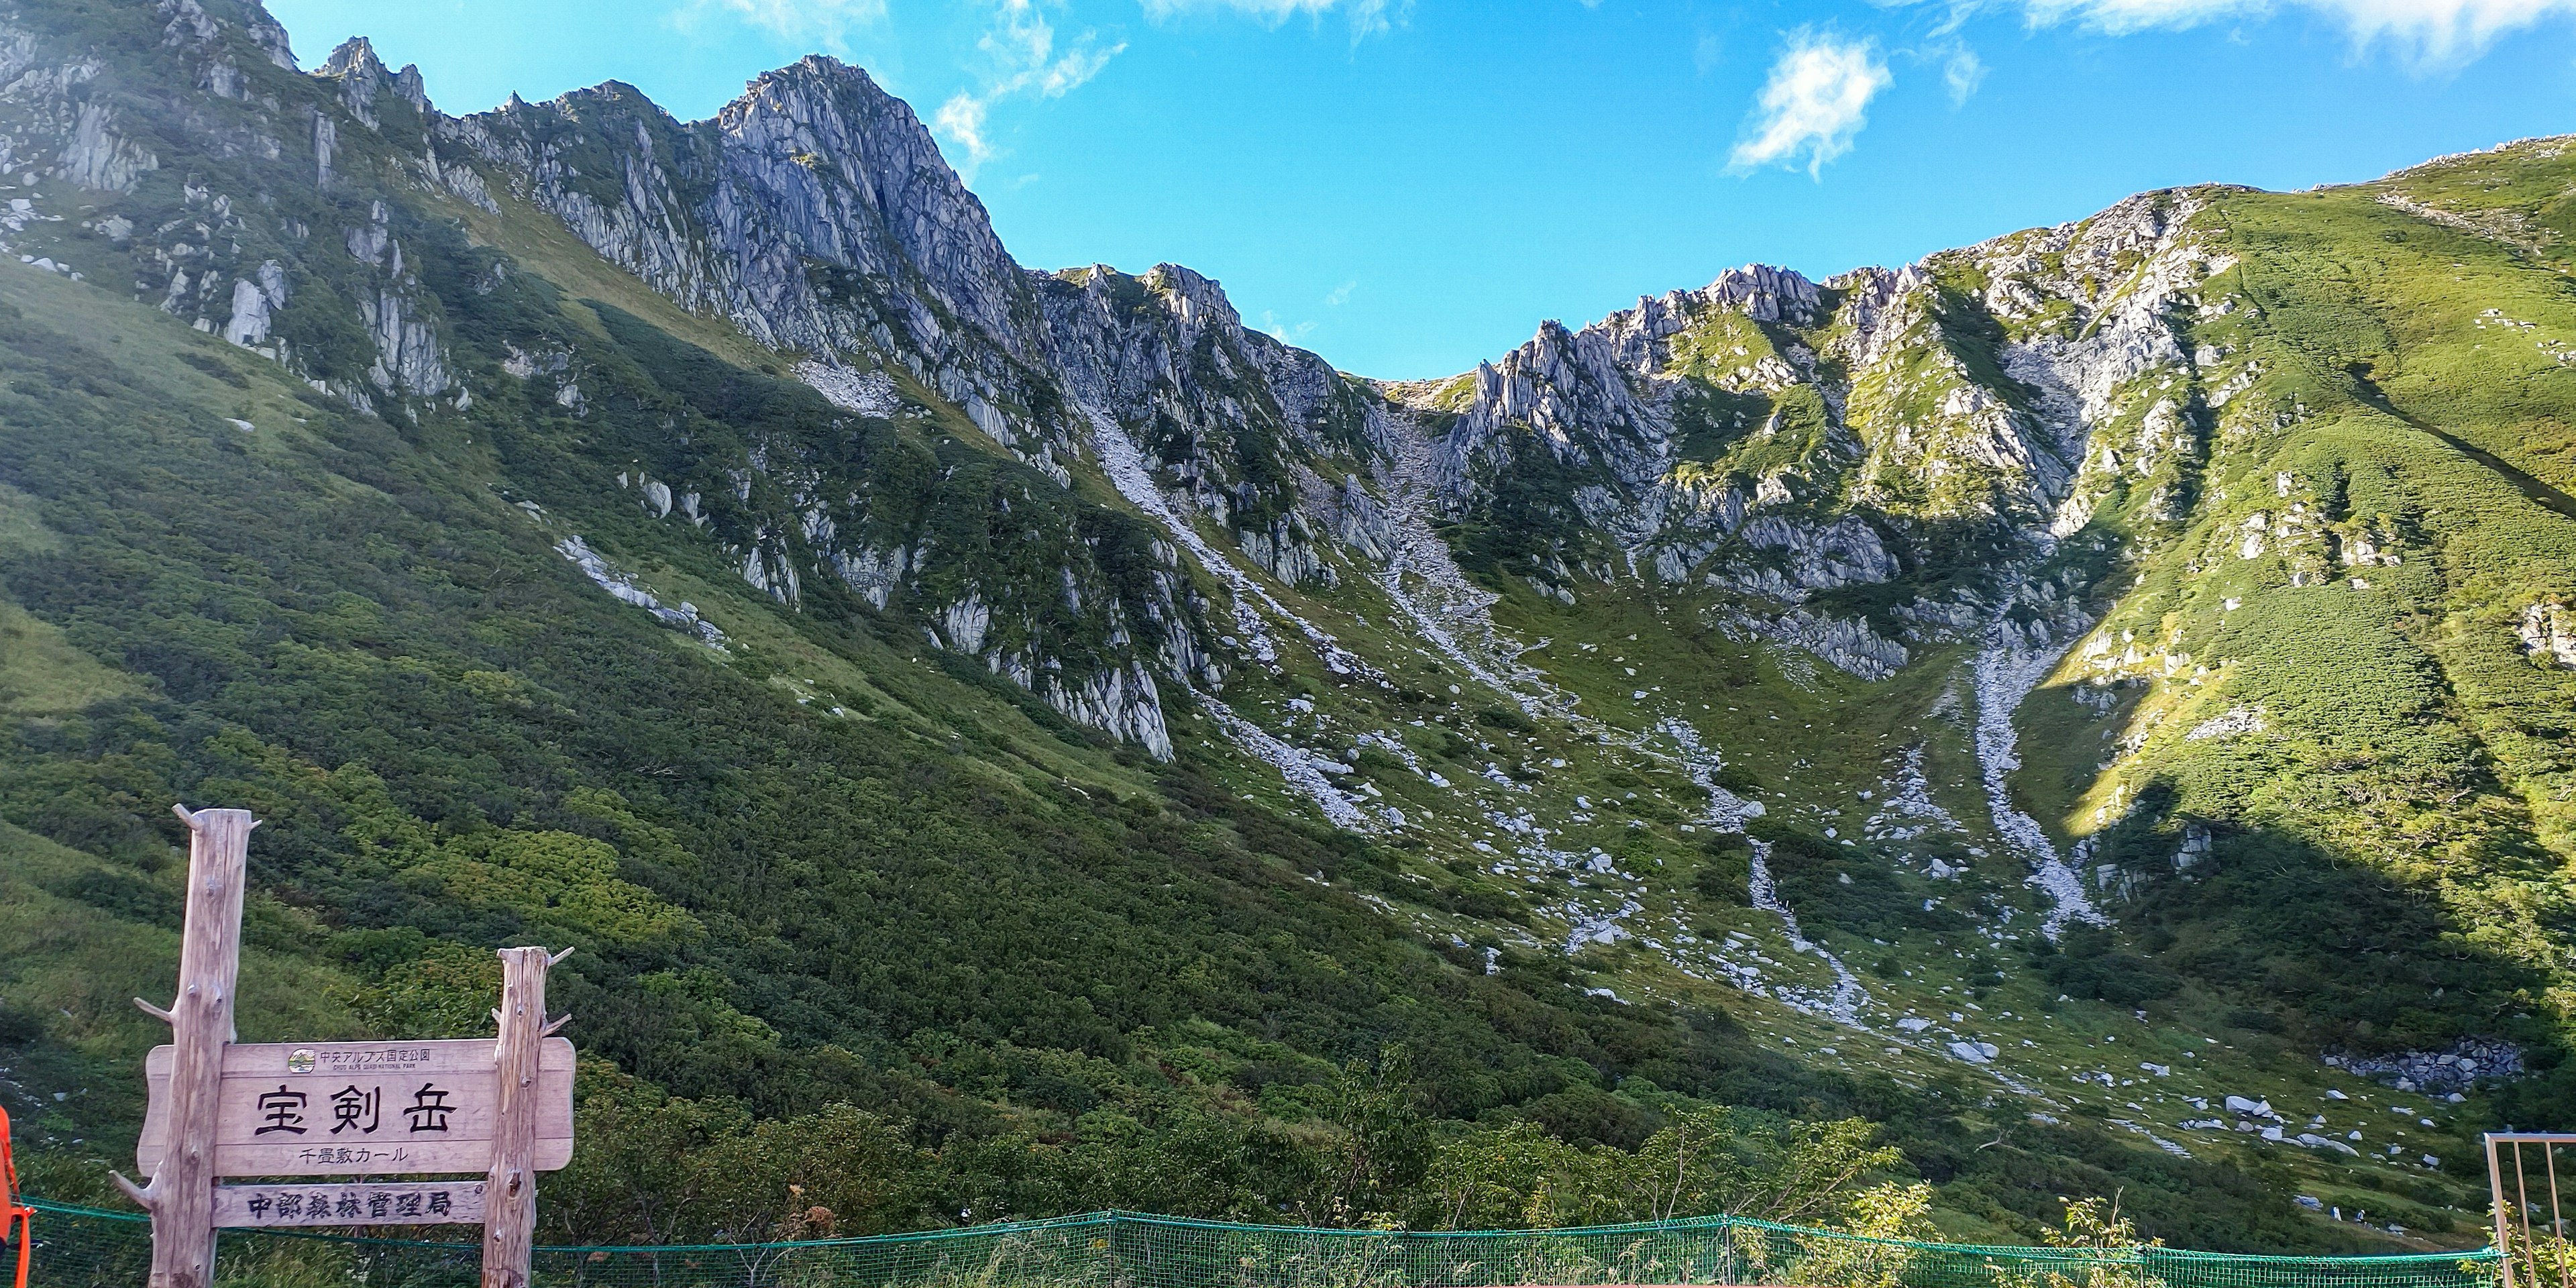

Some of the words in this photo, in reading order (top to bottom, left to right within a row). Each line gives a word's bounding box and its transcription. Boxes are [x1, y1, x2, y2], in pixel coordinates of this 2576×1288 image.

[320, 1049, 429, 1063] 中央アルプス国定公園
[255, 1083, 458, 1136] 宝剣岳
[300, 1148, 408, 1165] 千畳敷カール
[248, 1191, 452, 1220] 中部森林管理局
